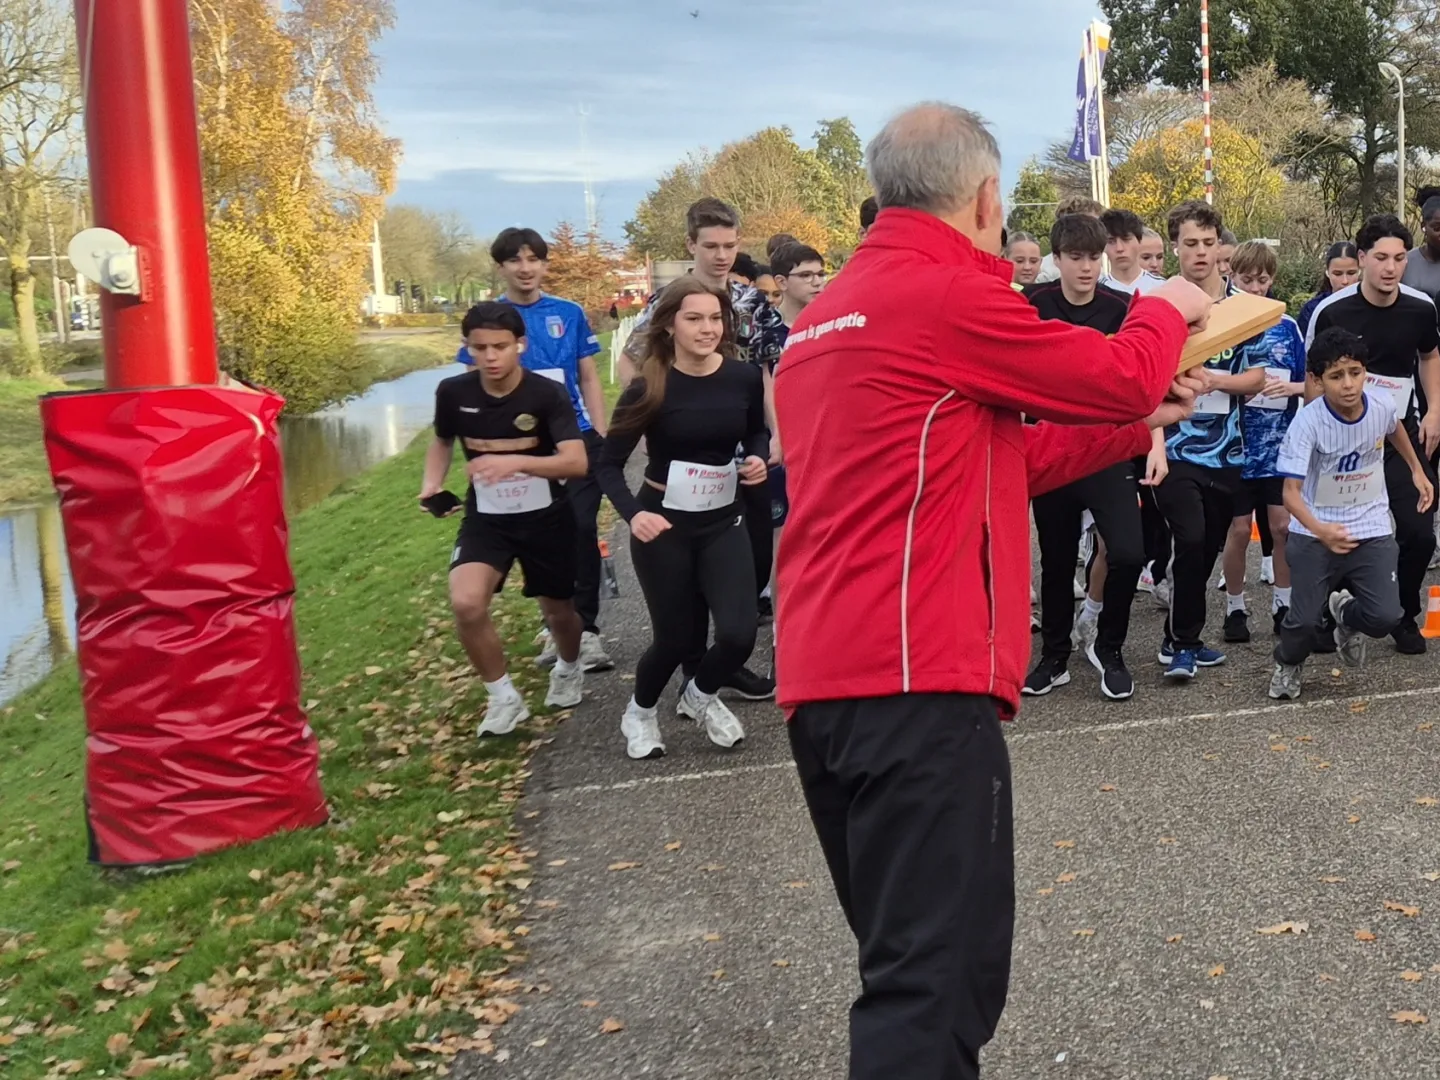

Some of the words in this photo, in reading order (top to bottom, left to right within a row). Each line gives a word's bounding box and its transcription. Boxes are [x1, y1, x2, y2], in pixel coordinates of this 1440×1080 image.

[834, 311, 867, 332] optie
[495, 485, 529, 498] 1167
[691, 483, 725, 495] 1129
[1337, 482, 1367, 495] 1171
